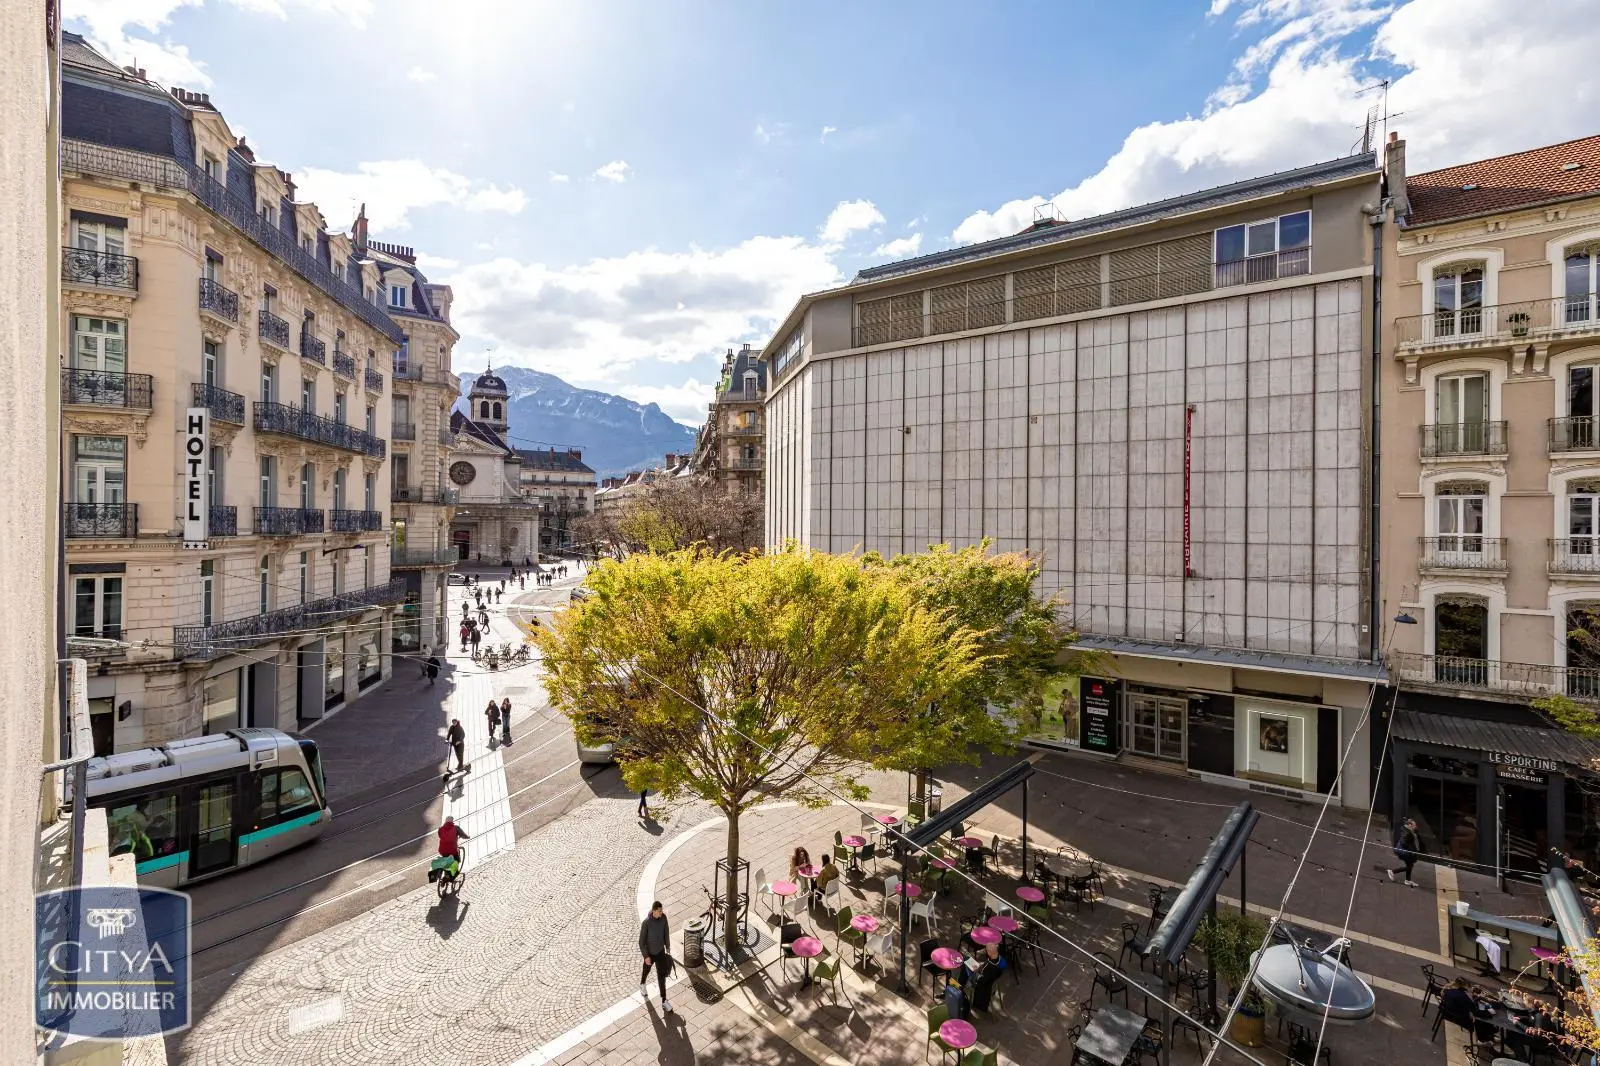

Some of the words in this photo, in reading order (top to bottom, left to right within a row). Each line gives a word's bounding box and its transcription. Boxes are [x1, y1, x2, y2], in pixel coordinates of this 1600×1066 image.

[186, 415, 204, 521] HOTEL
[1489, 752, 1501, 763] LE
[1504, 754, 1557, 771] SPORTING
[1500, 771, 1544, 783] BRASSERIE
